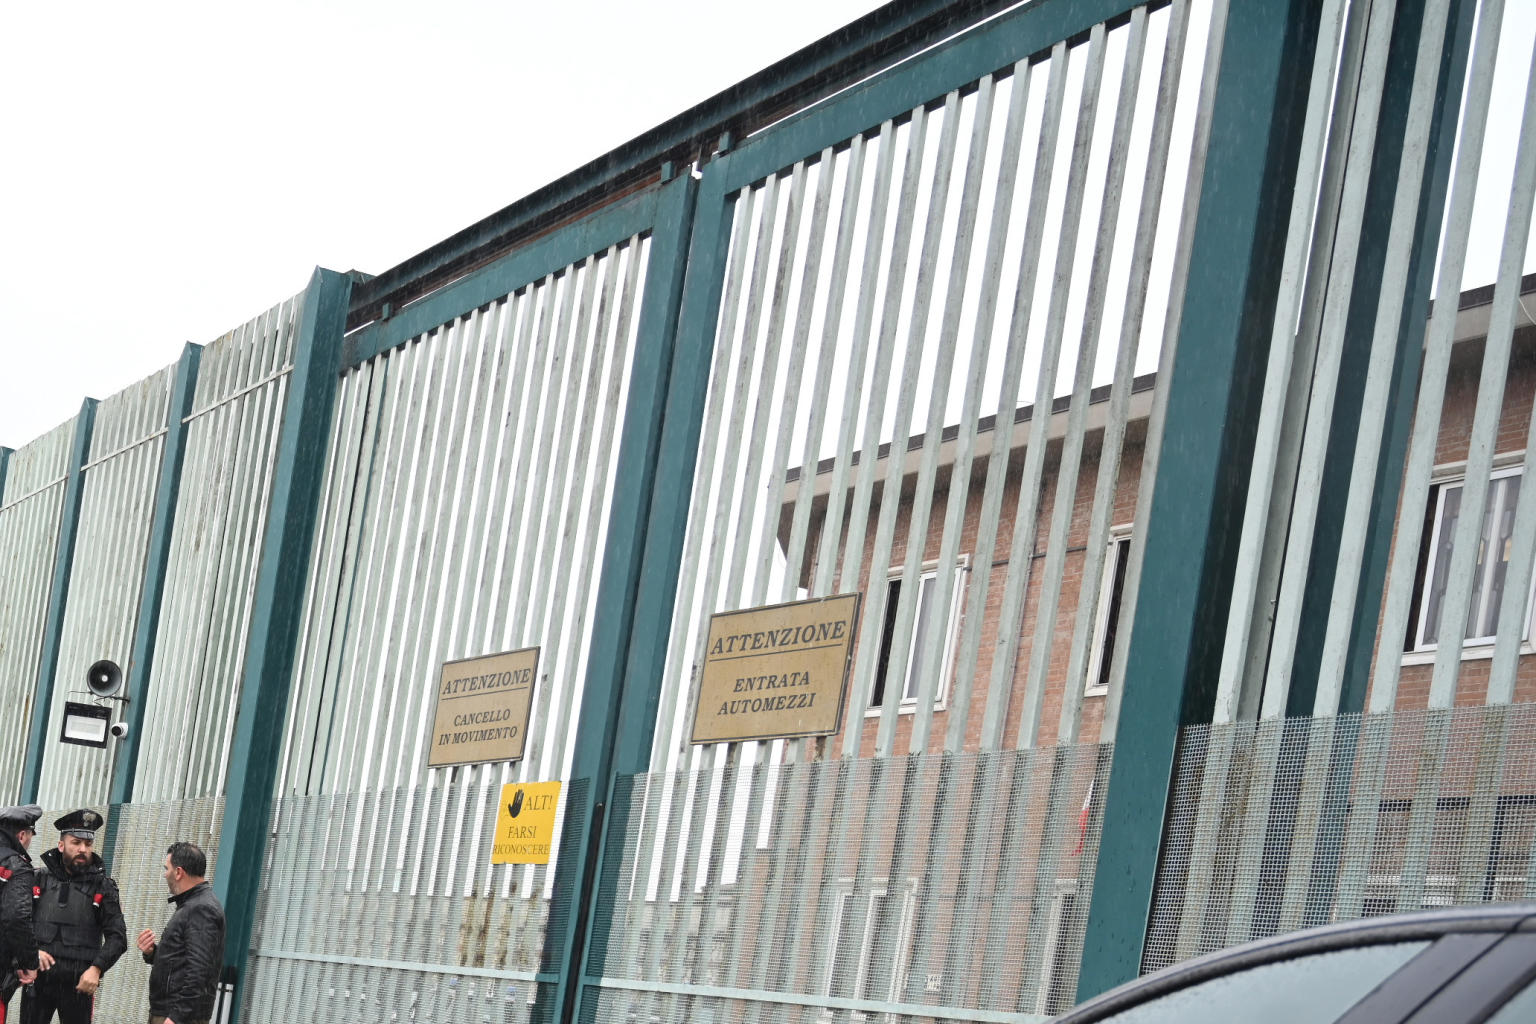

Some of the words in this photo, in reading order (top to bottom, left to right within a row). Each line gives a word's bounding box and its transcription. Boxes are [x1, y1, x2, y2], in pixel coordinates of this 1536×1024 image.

[710, 620, 846, 655] ATTENZIONE
[442, 668, 531, 695] ATTENZIONE
[733, 671, 810, 693] ENTRATA
[717, 693, 816, 715] AUTOMEZZI
[454, 708, 511, 726] CANCELLO
[438, 733, 451, 746] IN
[452, 726, 518, 744] MOVIMENTO
[524, 794, 553, 811] ALT!
[508, 825, 537, 839] FARSI
[492, 844, 551, 855] RICONOSCERE
